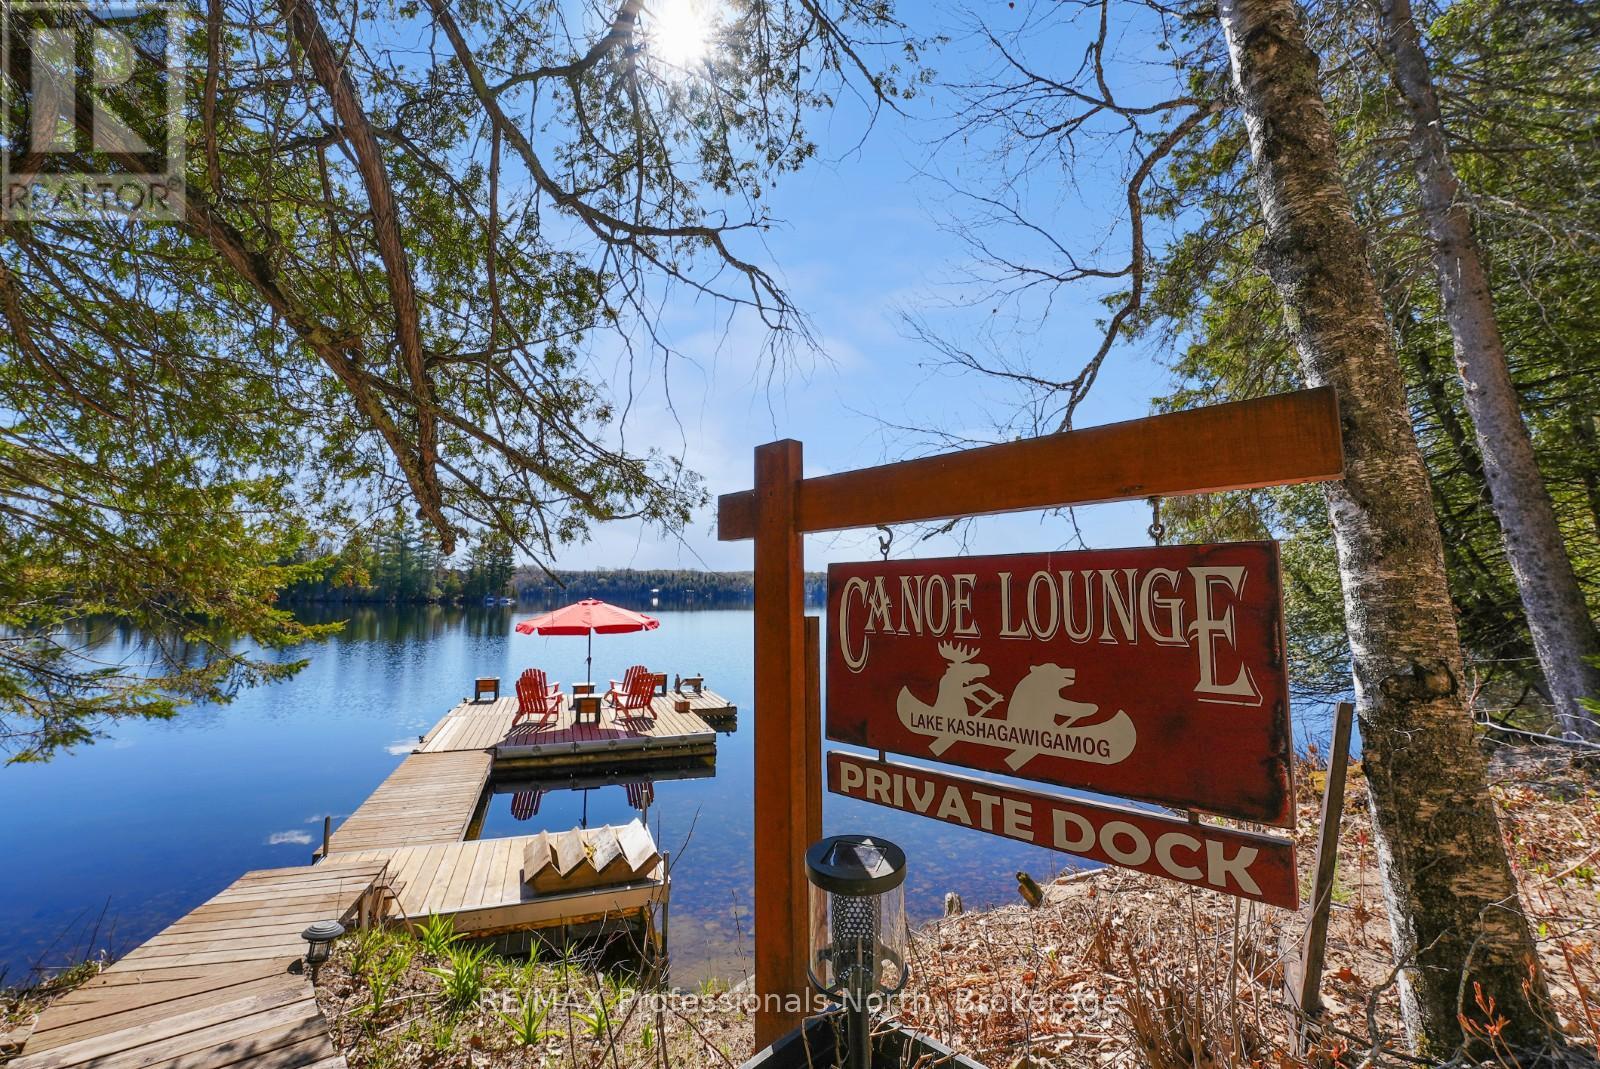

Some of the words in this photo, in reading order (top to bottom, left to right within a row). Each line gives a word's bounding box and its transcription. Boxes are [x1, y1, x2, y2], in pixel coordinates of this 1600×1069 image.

[839, 572, 981, 674] CANOE
[998, 565, 1263, 707] LOUNGE
[910, 712, 944, 732] LAKE
[947, 718, 1111, 758] KASHAGAWIGAMOG
[839, 761, 1036, 842] PRIVATE
[1052, 808, 1263, 896] DOCK
